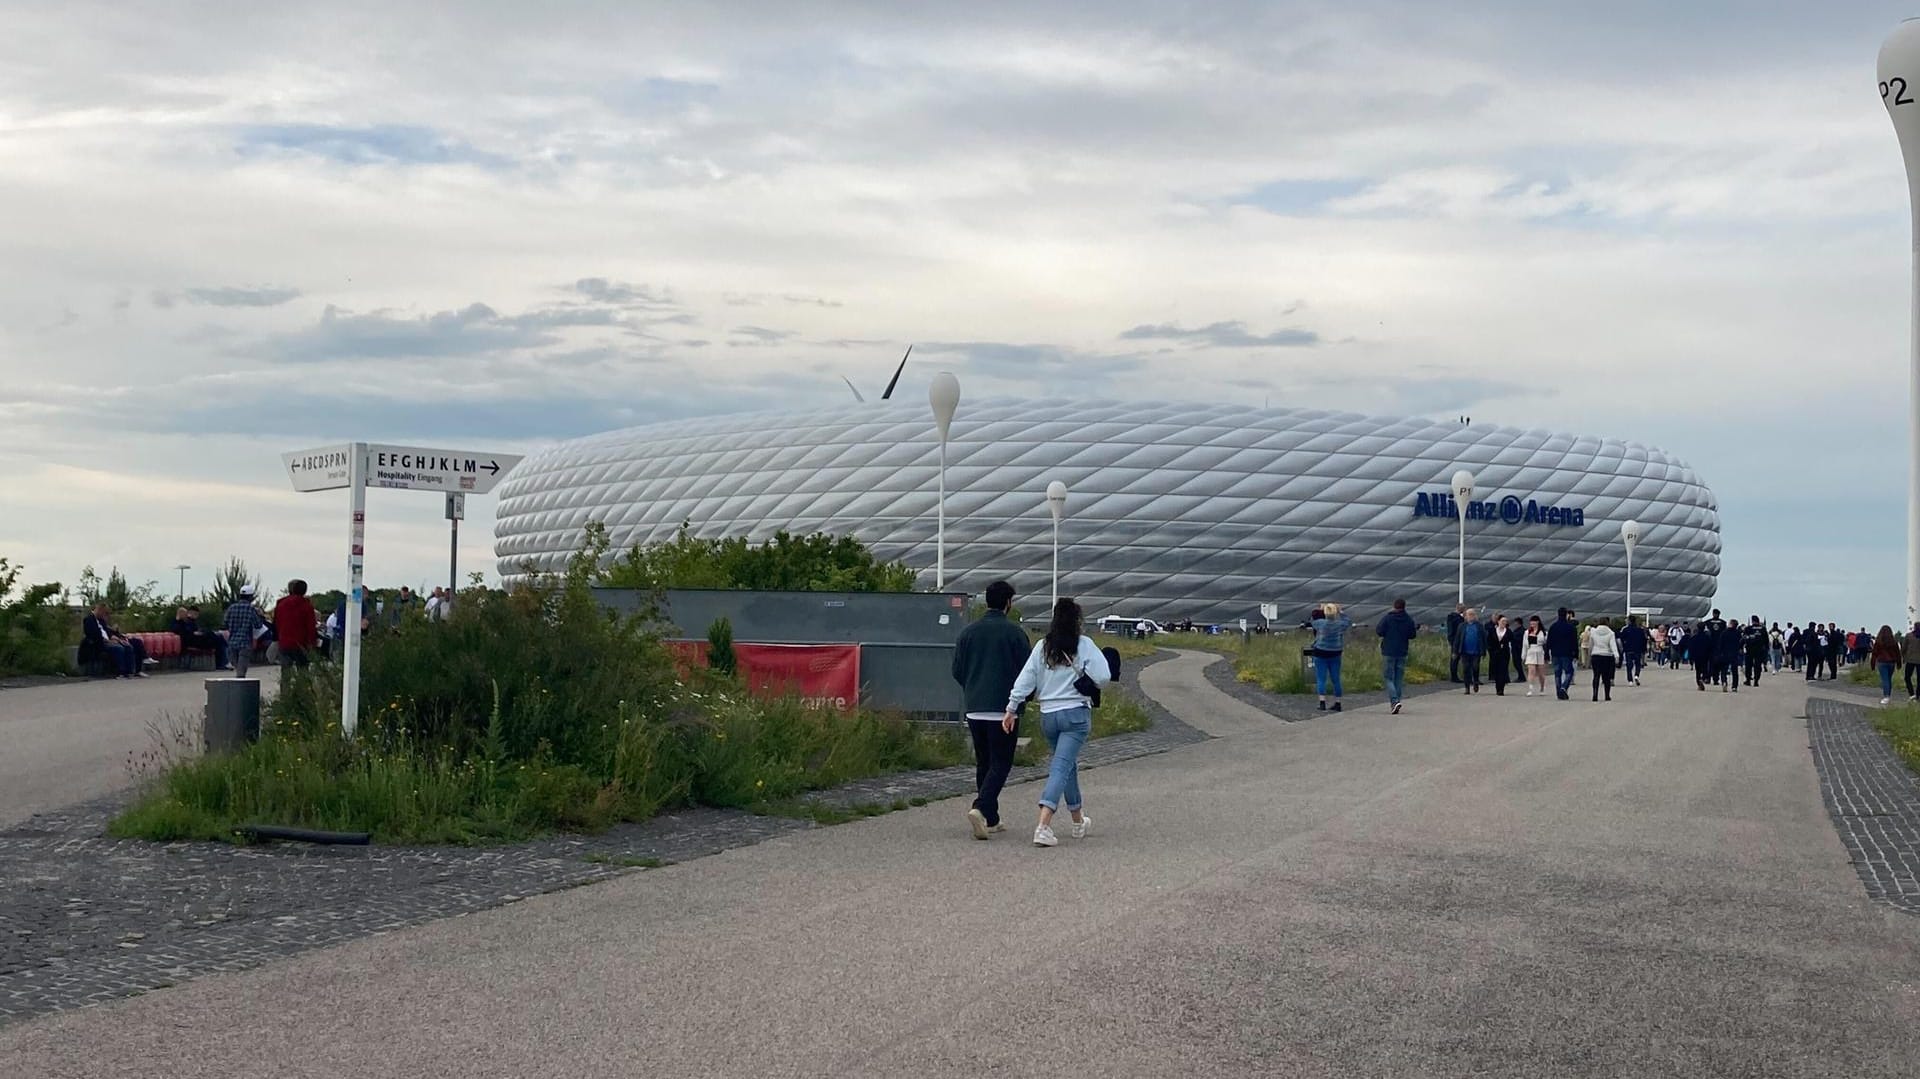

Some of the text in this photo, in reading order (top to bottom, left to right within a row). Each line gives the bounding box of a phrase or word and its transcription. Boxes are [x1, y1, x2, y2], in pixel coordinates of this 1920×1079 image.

[377, 471, 416, 481] Hospitality
[417, 473, 443, 484] Eingang
[1459, 487, 1471, 496] P1
[1524, 499, 1584, 526] Arena
